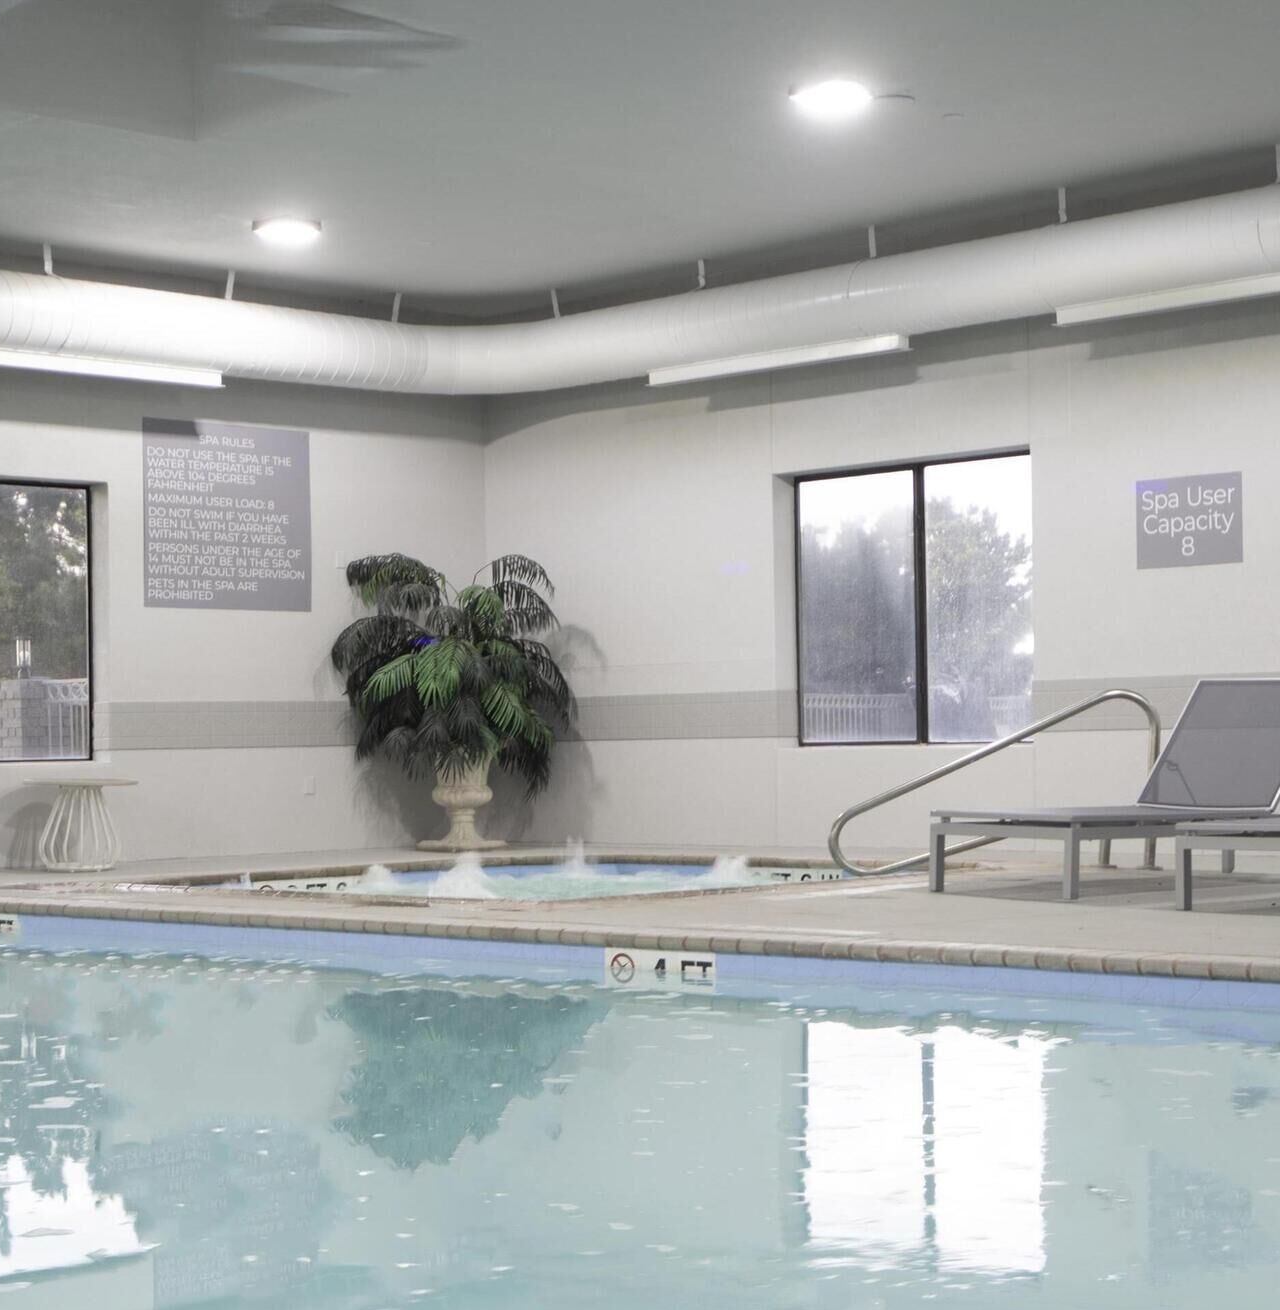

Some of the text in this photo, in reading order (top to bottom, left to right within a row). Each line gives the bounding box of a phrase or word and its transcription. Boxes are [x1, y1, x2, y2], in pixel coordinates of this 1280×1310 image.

[200, 435, 255, 449] SPA RULES
[147, 447, 292, 467] DO NOT USE THE SPA IF THE
[147, 458, 274, 476] WATER TEMPERATURE IS
[147, 469, 256, 485] ABOVE 104 DEGREES
[148, 480, 214, 492] FAHRENHEIT
[148, 494, 203, 504] MAXIMUM
[206, 496, 233, 506] USER
[1142, 486, 1235, 514] Spa User
[148, 507, 289, 524] DO NOT SWIM IF YOU HAVE
[1144, 509, 1234, 537] Capacity
[148, 518, 282, 534] BEEN ILL WITH DIARRHEA
[148, 529, 287, 545] WITHIN THE PAST 2 WEEKS
[148, 542, 302, 559] PERSONS UNDER THE AGE OF
[1182, 536, 1195, 556] 8
[149, 554, 292, 569] 14 MUST NOT BE IN THE SPA
[148, 565, 305, 580] WITHOUT ADULT SUPERVISION
[148, 578, 258, 592] PETS IN THE SPA ARE
[148, 589, 214, 600] PROHIBITED
